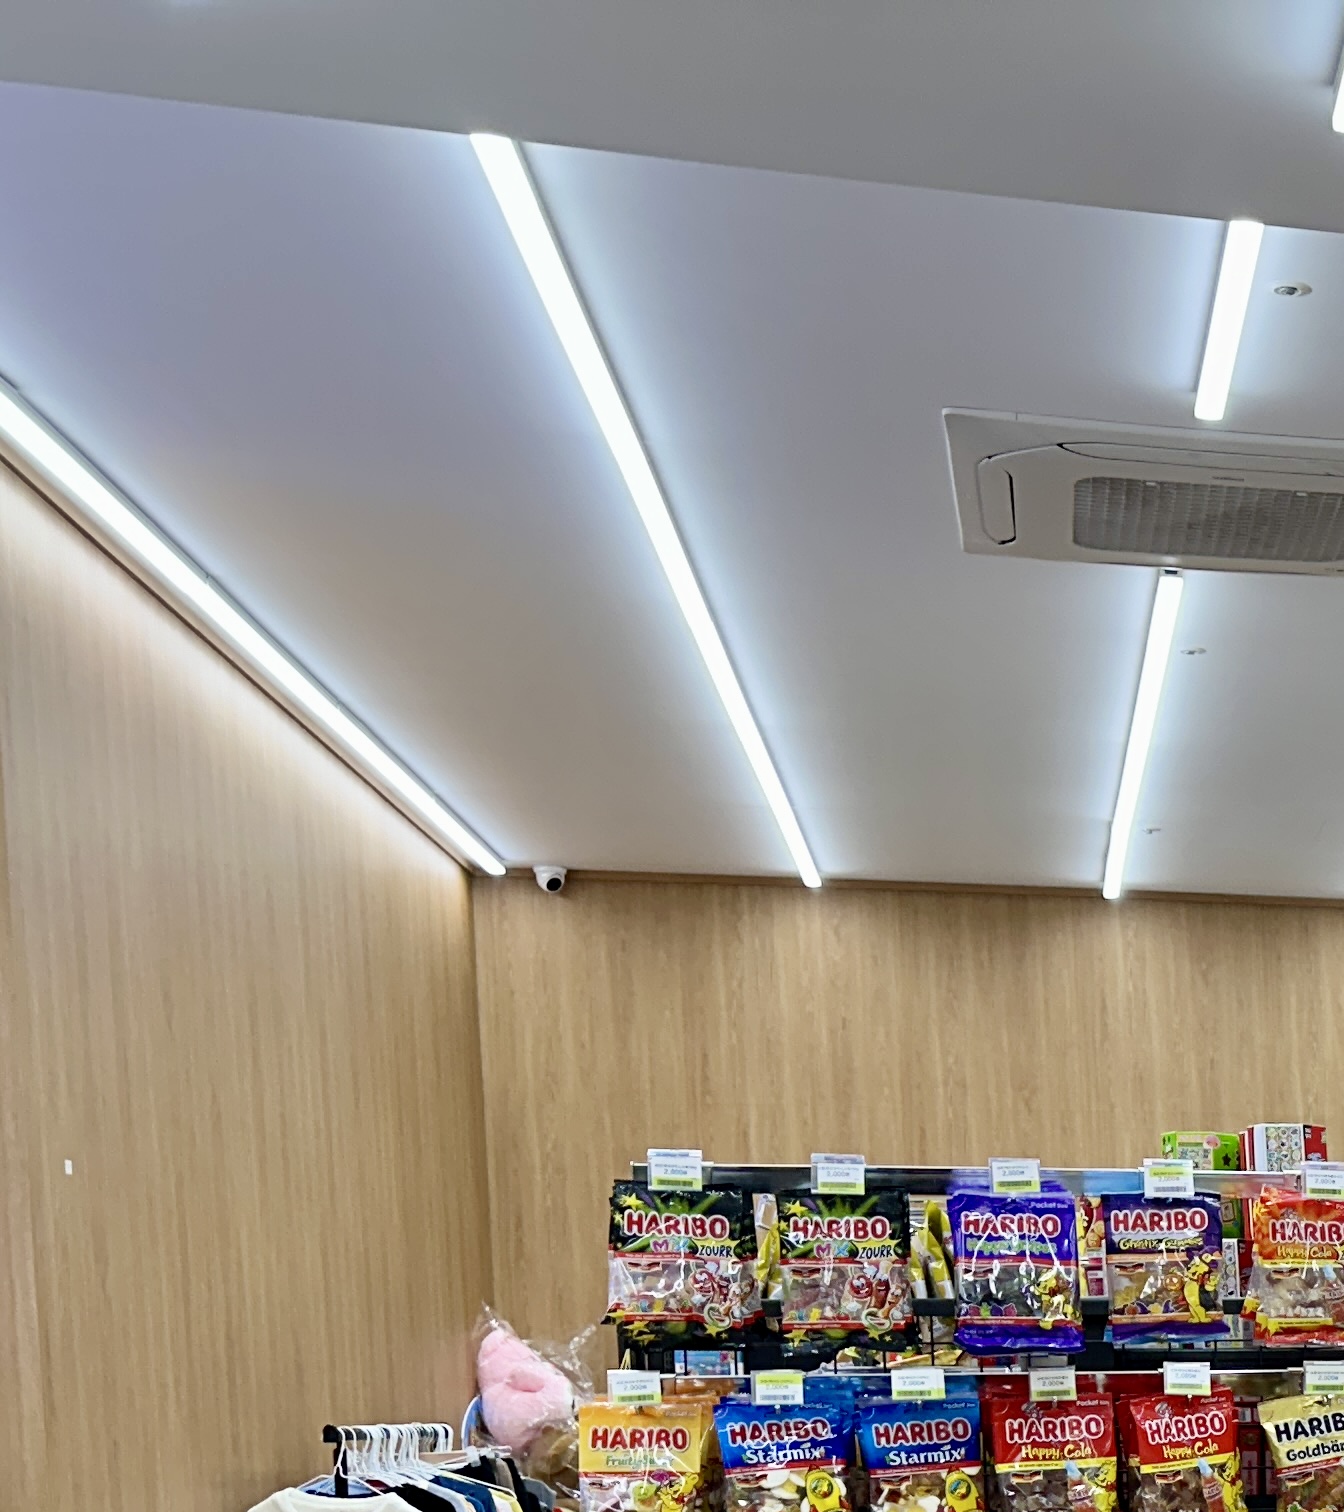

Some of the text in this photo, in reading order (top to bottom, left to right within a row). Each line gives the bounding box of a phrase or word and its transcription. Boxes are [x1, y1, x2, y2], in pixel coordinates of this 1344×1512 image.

[625, 1209, 730, 1240] HARIBO
[789, 1215, 890, 1241] HARIBO
[961, 1211, 1060, 1238] HARIBO
[1111, 1209, 1208, 1234] HARIBO
[699, 1243, 734, 1258] ZOURR
[859, 1242, 893, 1259] ZOURR
[590, 1426, 689, 1451] HARIBO
[728, 1418, 831, 1446] HARIBO
[873, 1417, 971, 1446] HARIBO
[1004, 1414, 1105, 1442] HARIBO
[1145, 1410, 1228, 1443] HARIBO
[887, 1444, 961, 1466] Starmix
[1022, 1443, 1093, 1461] Happy Cola
